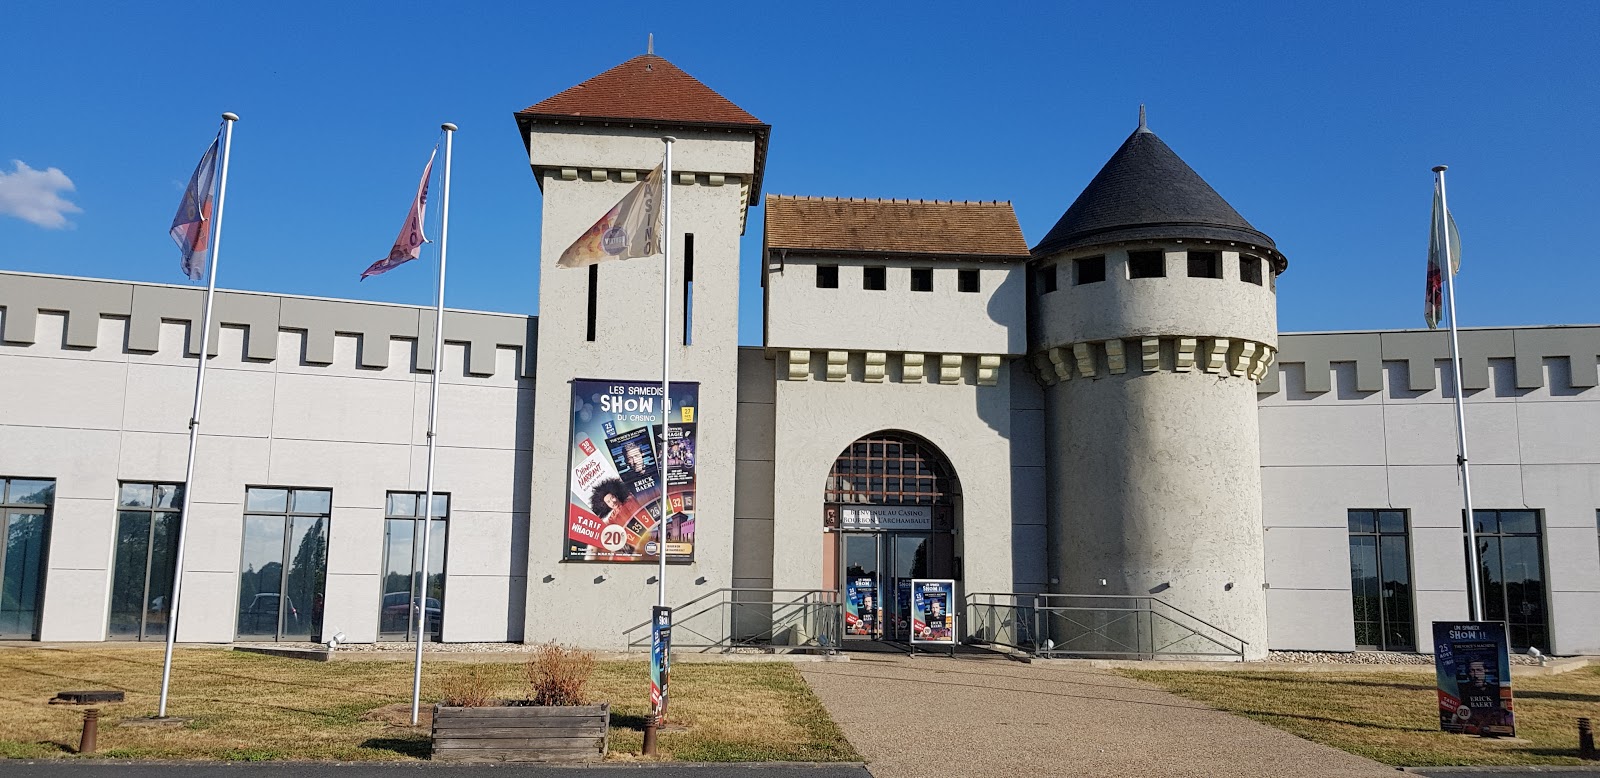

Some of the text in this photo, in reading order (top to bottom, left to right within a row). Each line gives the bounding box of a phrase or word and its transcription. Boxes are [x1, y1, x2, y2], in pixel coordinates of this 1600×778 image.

[609, 386, 625, 394] LES
[600, 394, 653, 413] SHOW
[630, 414, 656, 422] CASINO
[633, 476, 654, 487] ERICK
[635, 481, 656, 493] BAERT
[672, 498, 682, 507] 32
[685, 496, 692, 506] 15
[650, 507, 660, 518] 26
[577, 516, 602, 530] TARIF
[641, 515, 649, 523] 3
[632, 522, 643, 533] 35
[1449, 630, 1476, 639] SHOW
[1439, 643, 1448, 653] 25
